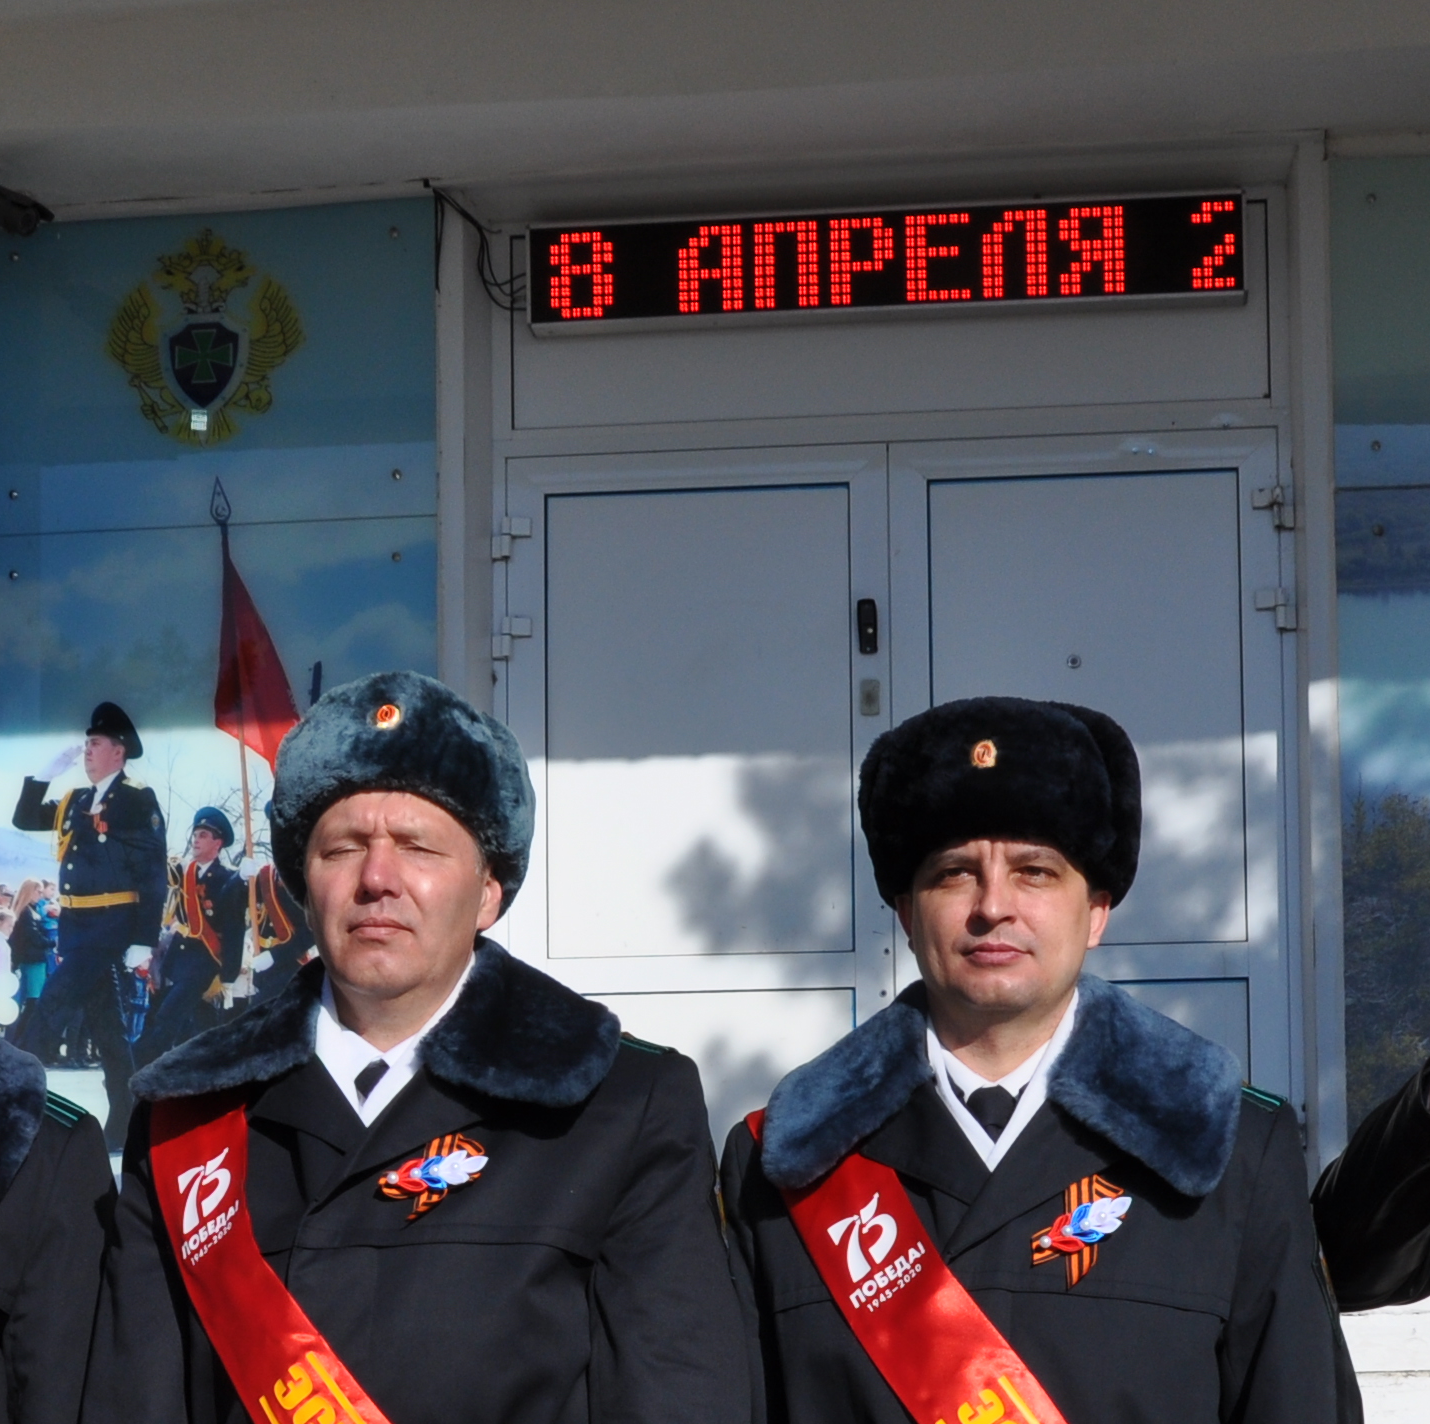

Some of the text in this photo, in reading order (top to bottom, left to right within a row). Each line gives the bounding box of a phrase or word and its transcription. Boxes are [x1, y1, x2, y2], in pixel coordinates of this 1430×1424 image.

[549, 231, 614, 318] 8
[678, 205, 1125, 313] АПРЕЛЯ
[177, 1146, 232, 1235] 75
[181, 1199, 240, 1260] ПОБЕДА!
[827, 1191, 898, 1284] 75
[849, 1241, 926, 1310] ПОБЕДА!
